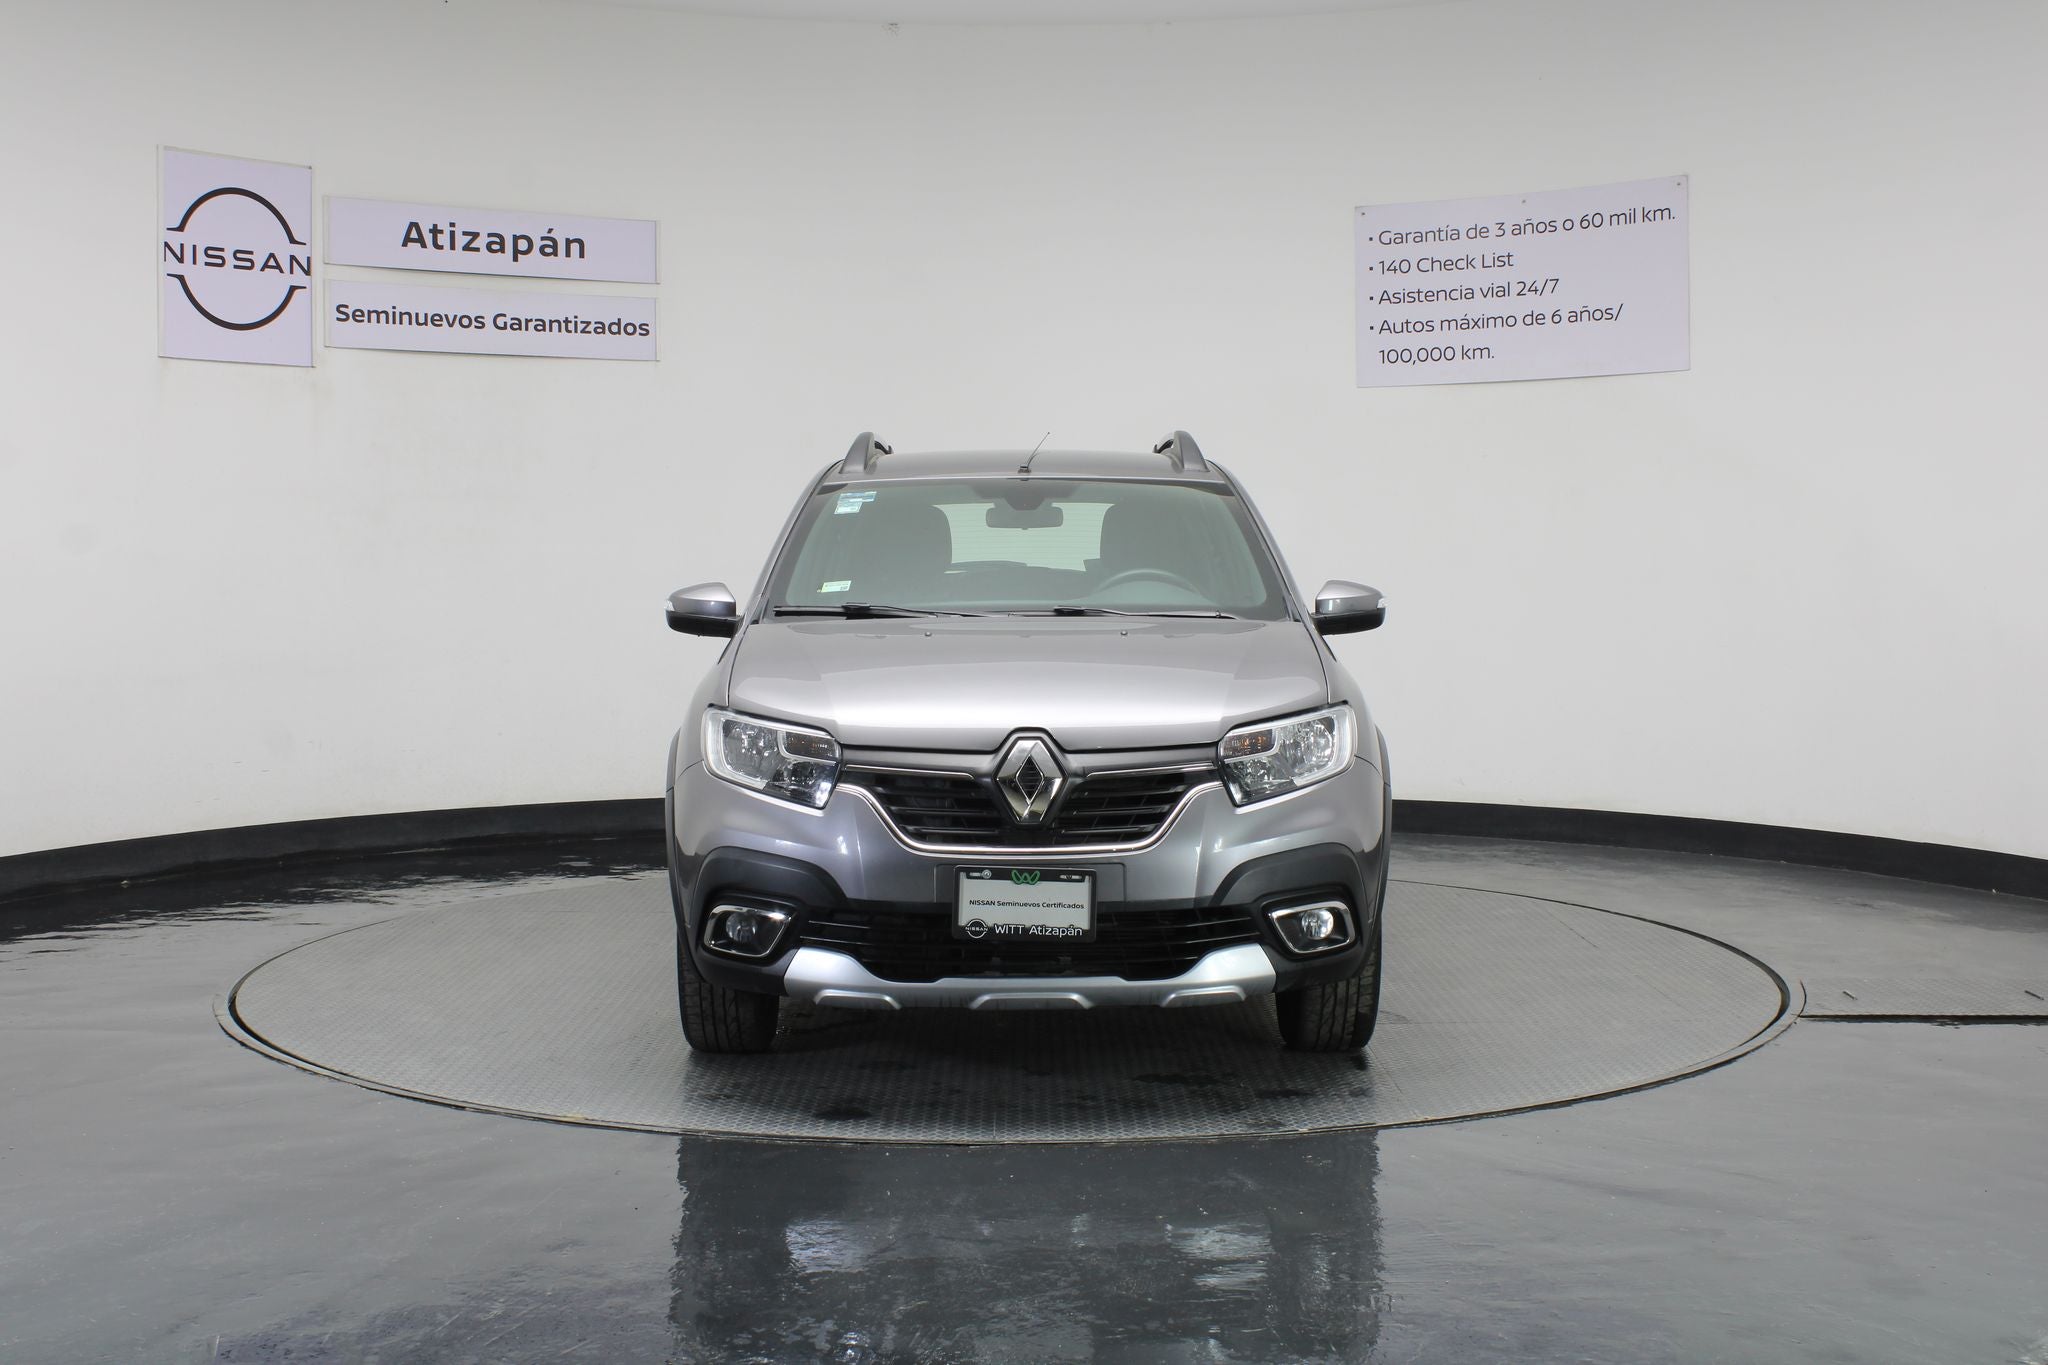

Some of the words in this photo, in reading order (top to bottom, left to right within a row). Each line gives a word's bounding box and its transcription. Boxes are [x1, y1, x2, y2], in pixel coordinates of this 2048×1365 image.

[1378, 223, 1460, 246] Garantía
[1466, 223, 1490, 240] de
[1495, 222, 1506, 238] 3
[1511, 218, 1558, 236] años
[1562, 218, 1575, 232] o
[1579, 212, 1604, 230] 60
[1609, 208, 1637, 227] mil
[1641, 206, 1676, 223] km.
[401, 221, 586, 263] Atizapán
[163, 240, 312, 277] NISSAN
[1378, 258, 1412, 275] 140
[1416, 253, 1476, 273] Check
[1481, 252, 1514, 269] List
[1378, 285, 1475, 305] Asistencia
[1479, 281, 1511, 299] vial
[1516, 278, 1560, 297] 24/7
[335, 303, 486, 330] Seminuevos
[492, 312, 651, 337] Garantizados
[1378, 318, 1435, 335] Autos
[1440, 313, 1518, 332] máximo
[1522, 309, 1546, 327] de
[1551, 308, 1562, 325] 6
[1567, 303, 1624, 324] años/
[1378, 346, 1456, 366] 100,000
[1461, 344, 1495, 361] km.
[996, 900, 1041, 908] Seminuevos
[1041, 901, 1085, 909] Certificados
[994, 924, 1026, 935] WITT
[1028, 924, 1083, 938] Atizapán
